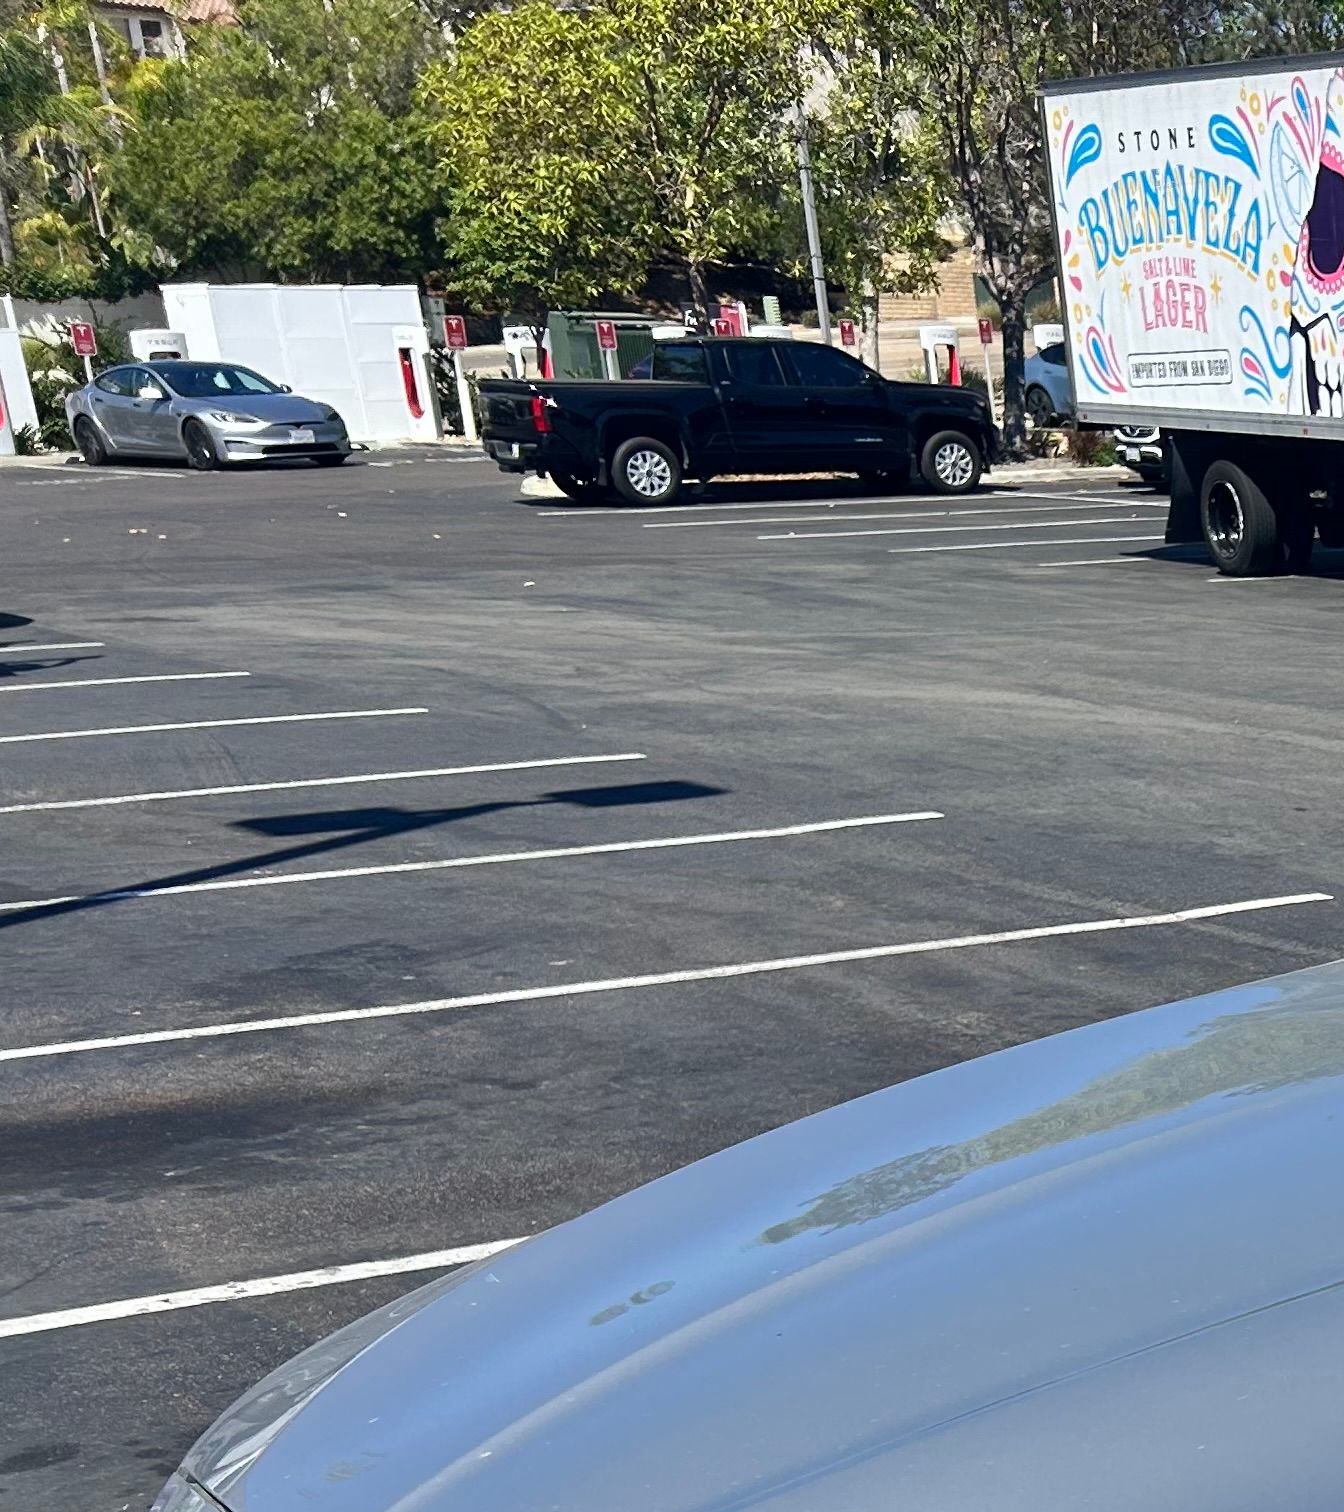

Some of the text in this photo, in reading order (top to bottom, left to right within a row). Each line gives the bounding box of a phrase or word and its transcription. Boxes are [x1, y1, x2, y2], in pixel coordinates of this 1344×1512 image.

[1118, 127, 1196, 153] STONE
[1079, 160, 1262, 276] BUENAVEZA
[1143, 256, 1197, 280] SALT & LIME
[1139, 279, 1208, 334] LAGER
[1131, 358, 1229, 379] IMPORTED FROM SAN DIEGO
